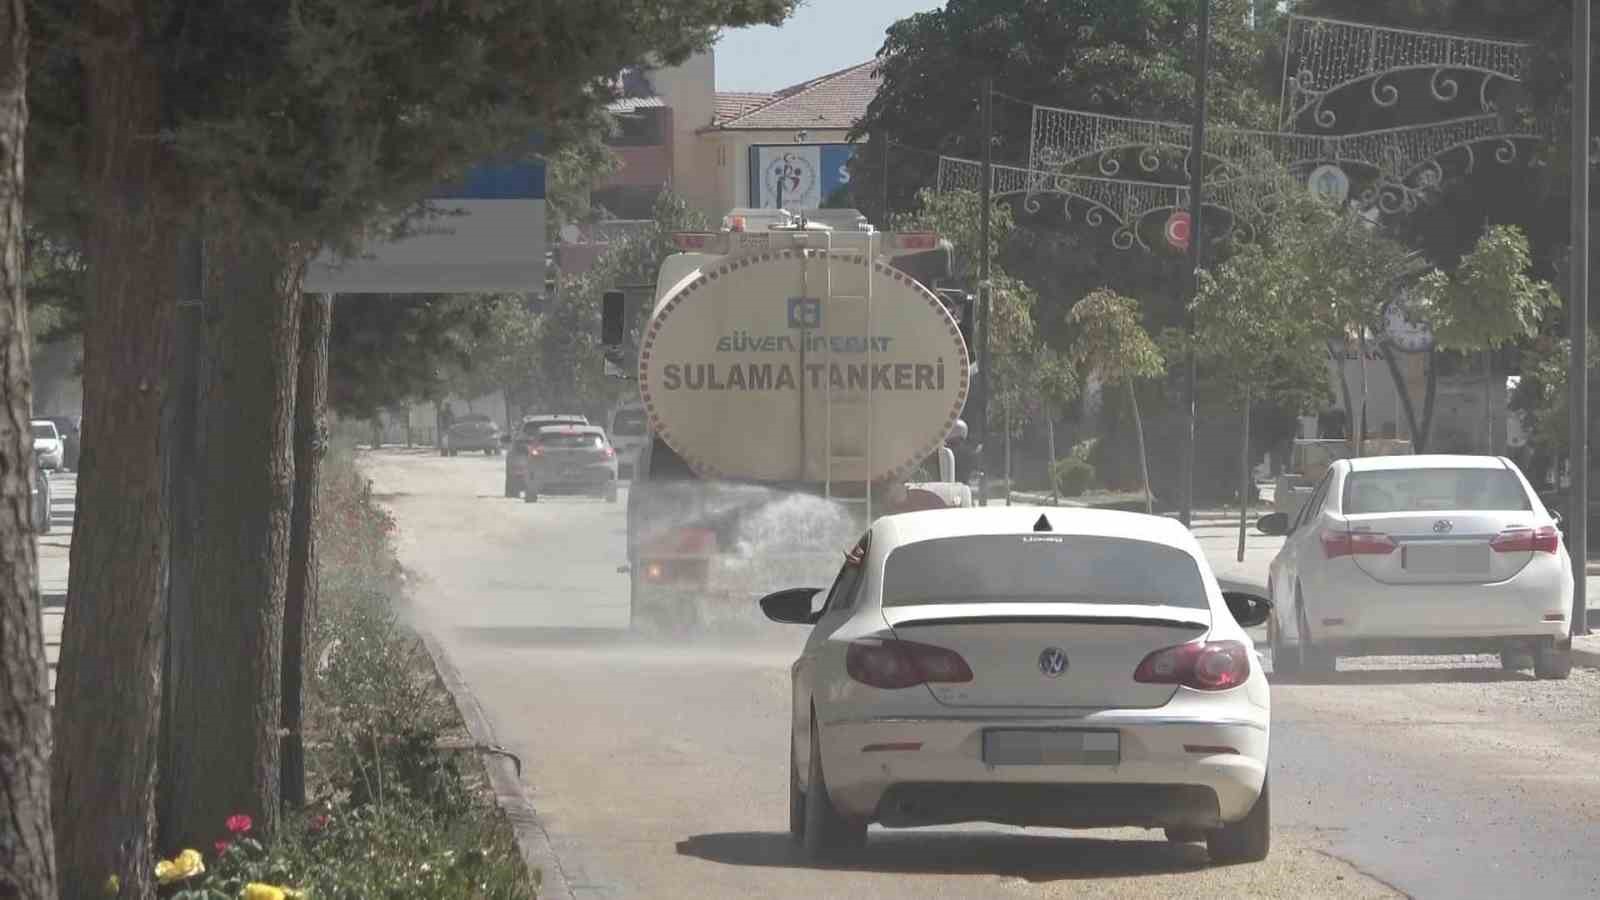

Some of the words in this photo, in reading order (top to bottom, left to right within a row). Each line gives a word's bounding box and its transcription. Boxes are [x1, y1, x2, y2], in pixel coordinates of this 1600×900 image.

[715, 329, 796, 353] GÜVEN
[663, 363, 797, 390] SULAMA
[804, 357, 945, 390] TANKERİ
